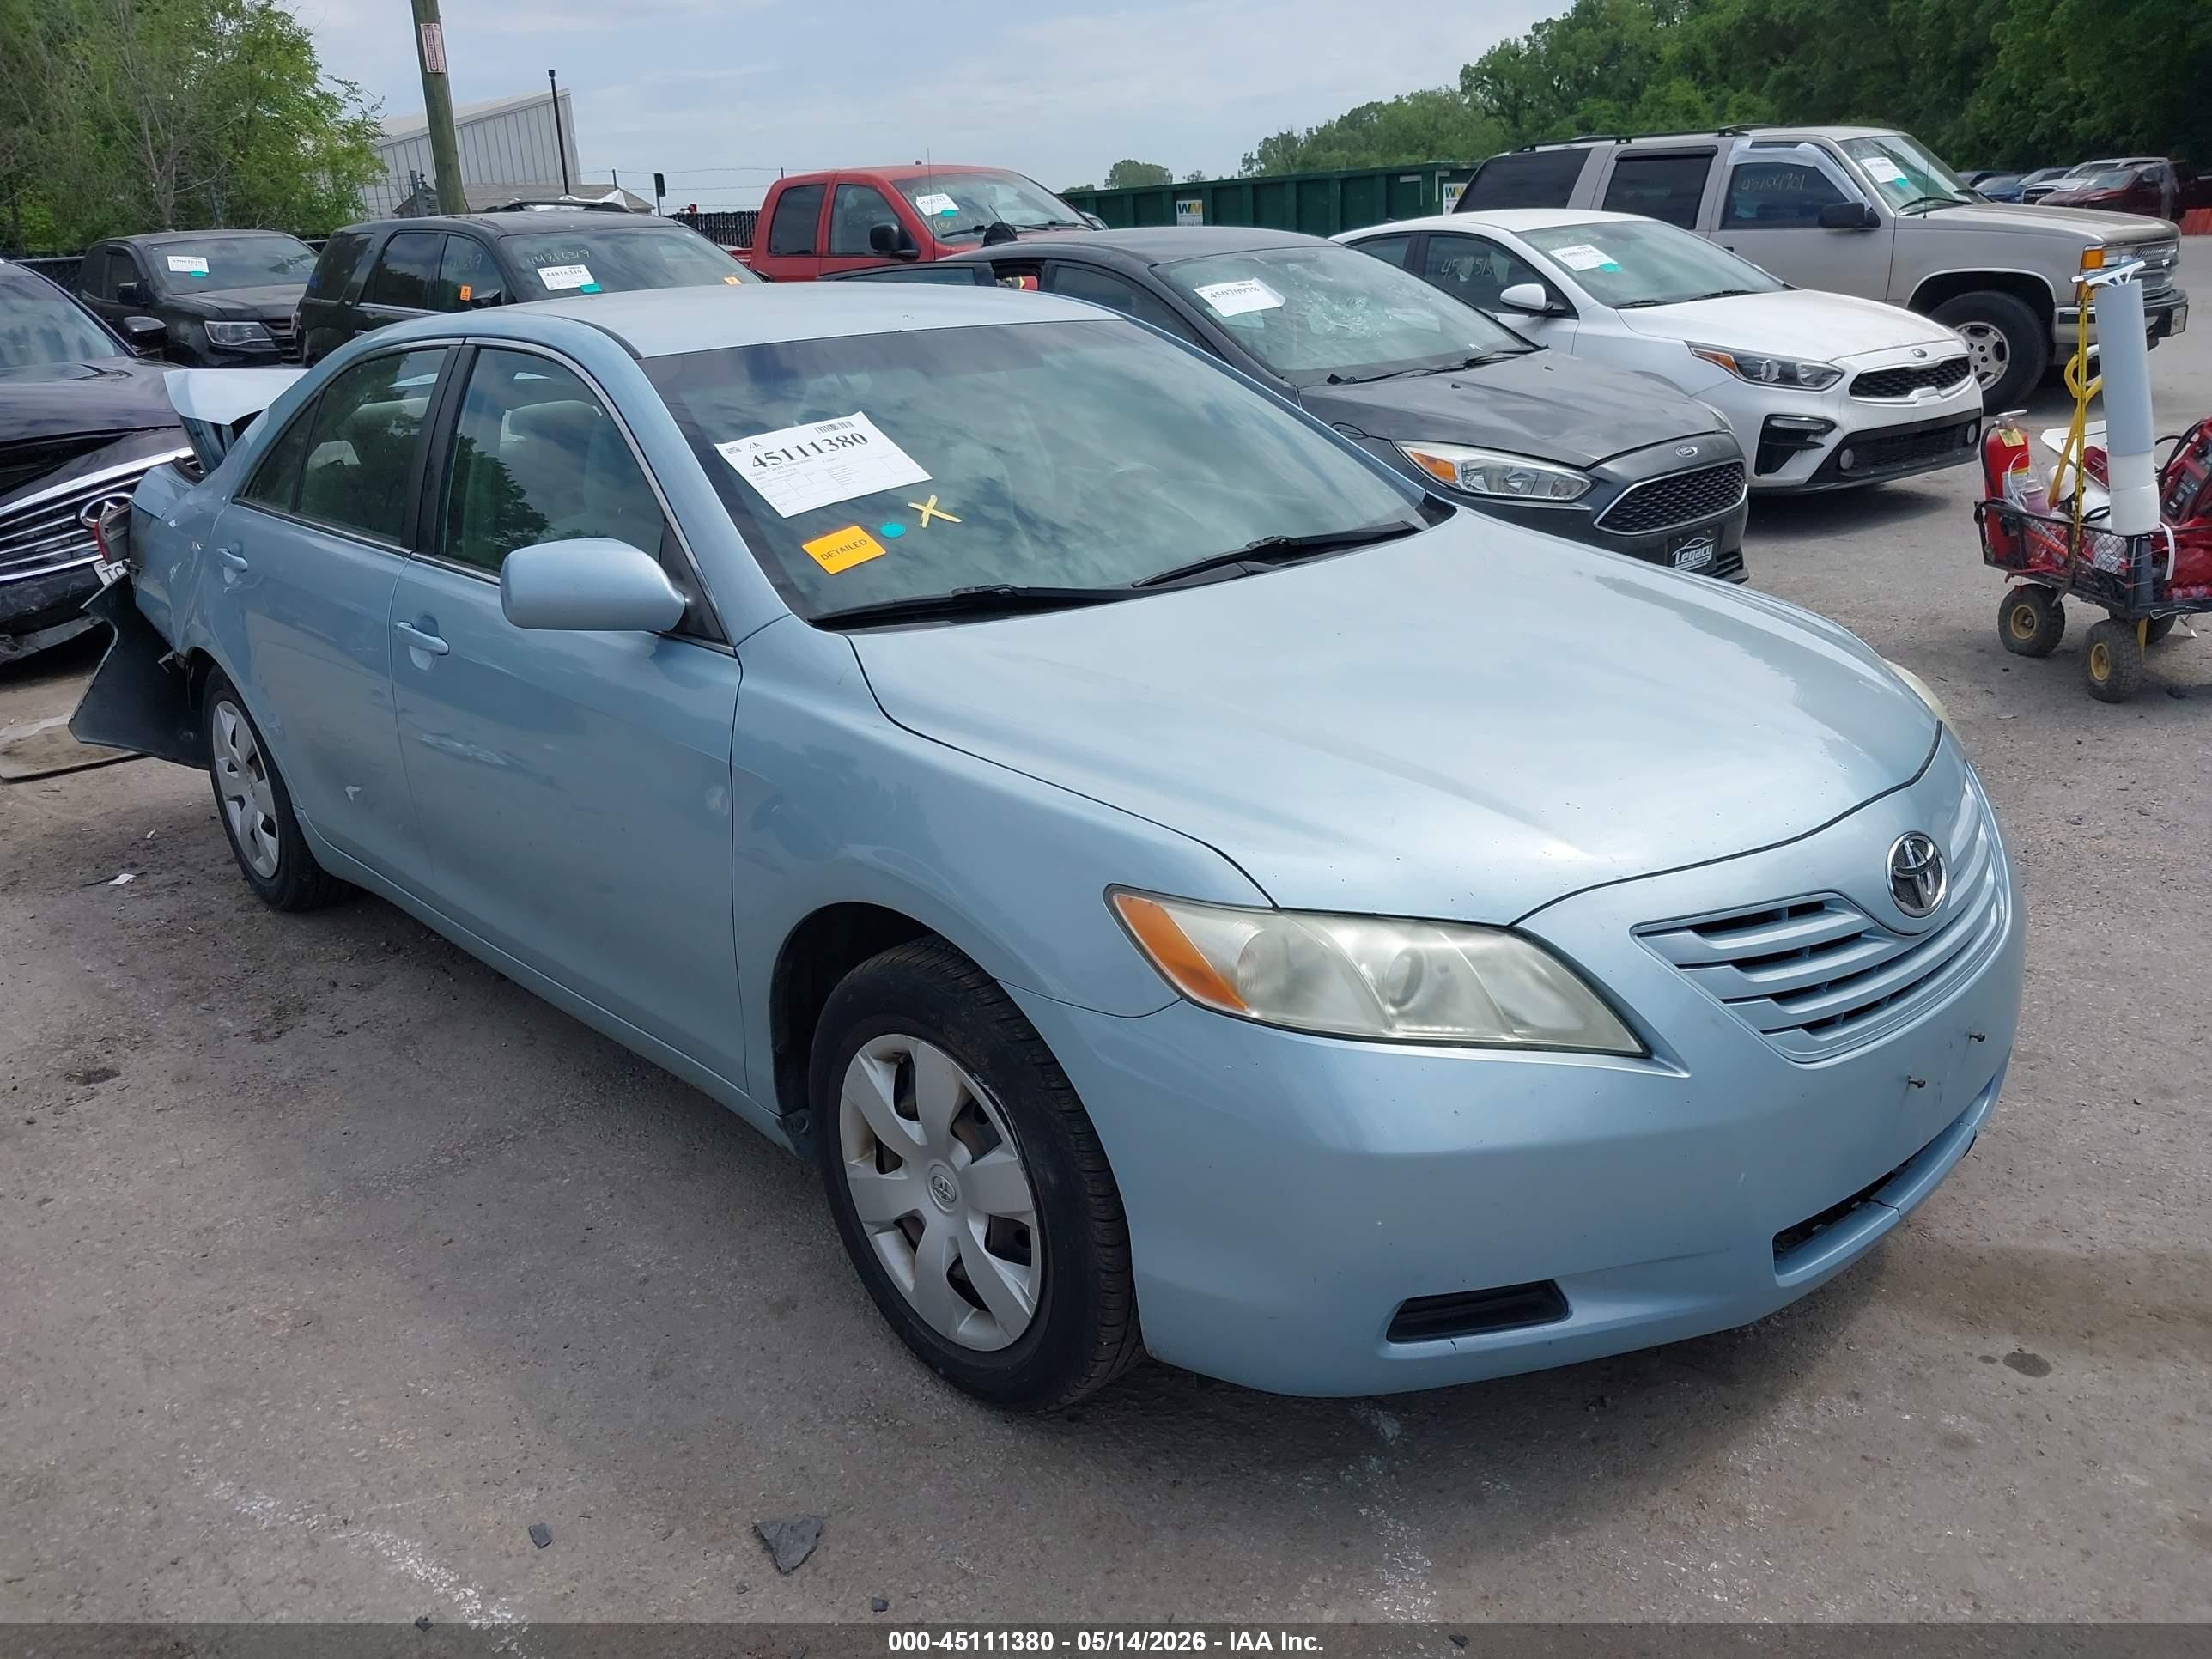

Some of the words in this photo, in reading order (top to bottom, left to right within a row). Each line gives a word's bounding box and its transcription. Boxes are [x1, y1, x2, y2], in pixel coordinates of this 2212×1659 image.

[751, 432, 868, 468] 45111380
[819, 538, 868, 561] DETAILED
[1674, 544, 1714, 568] Legacy
